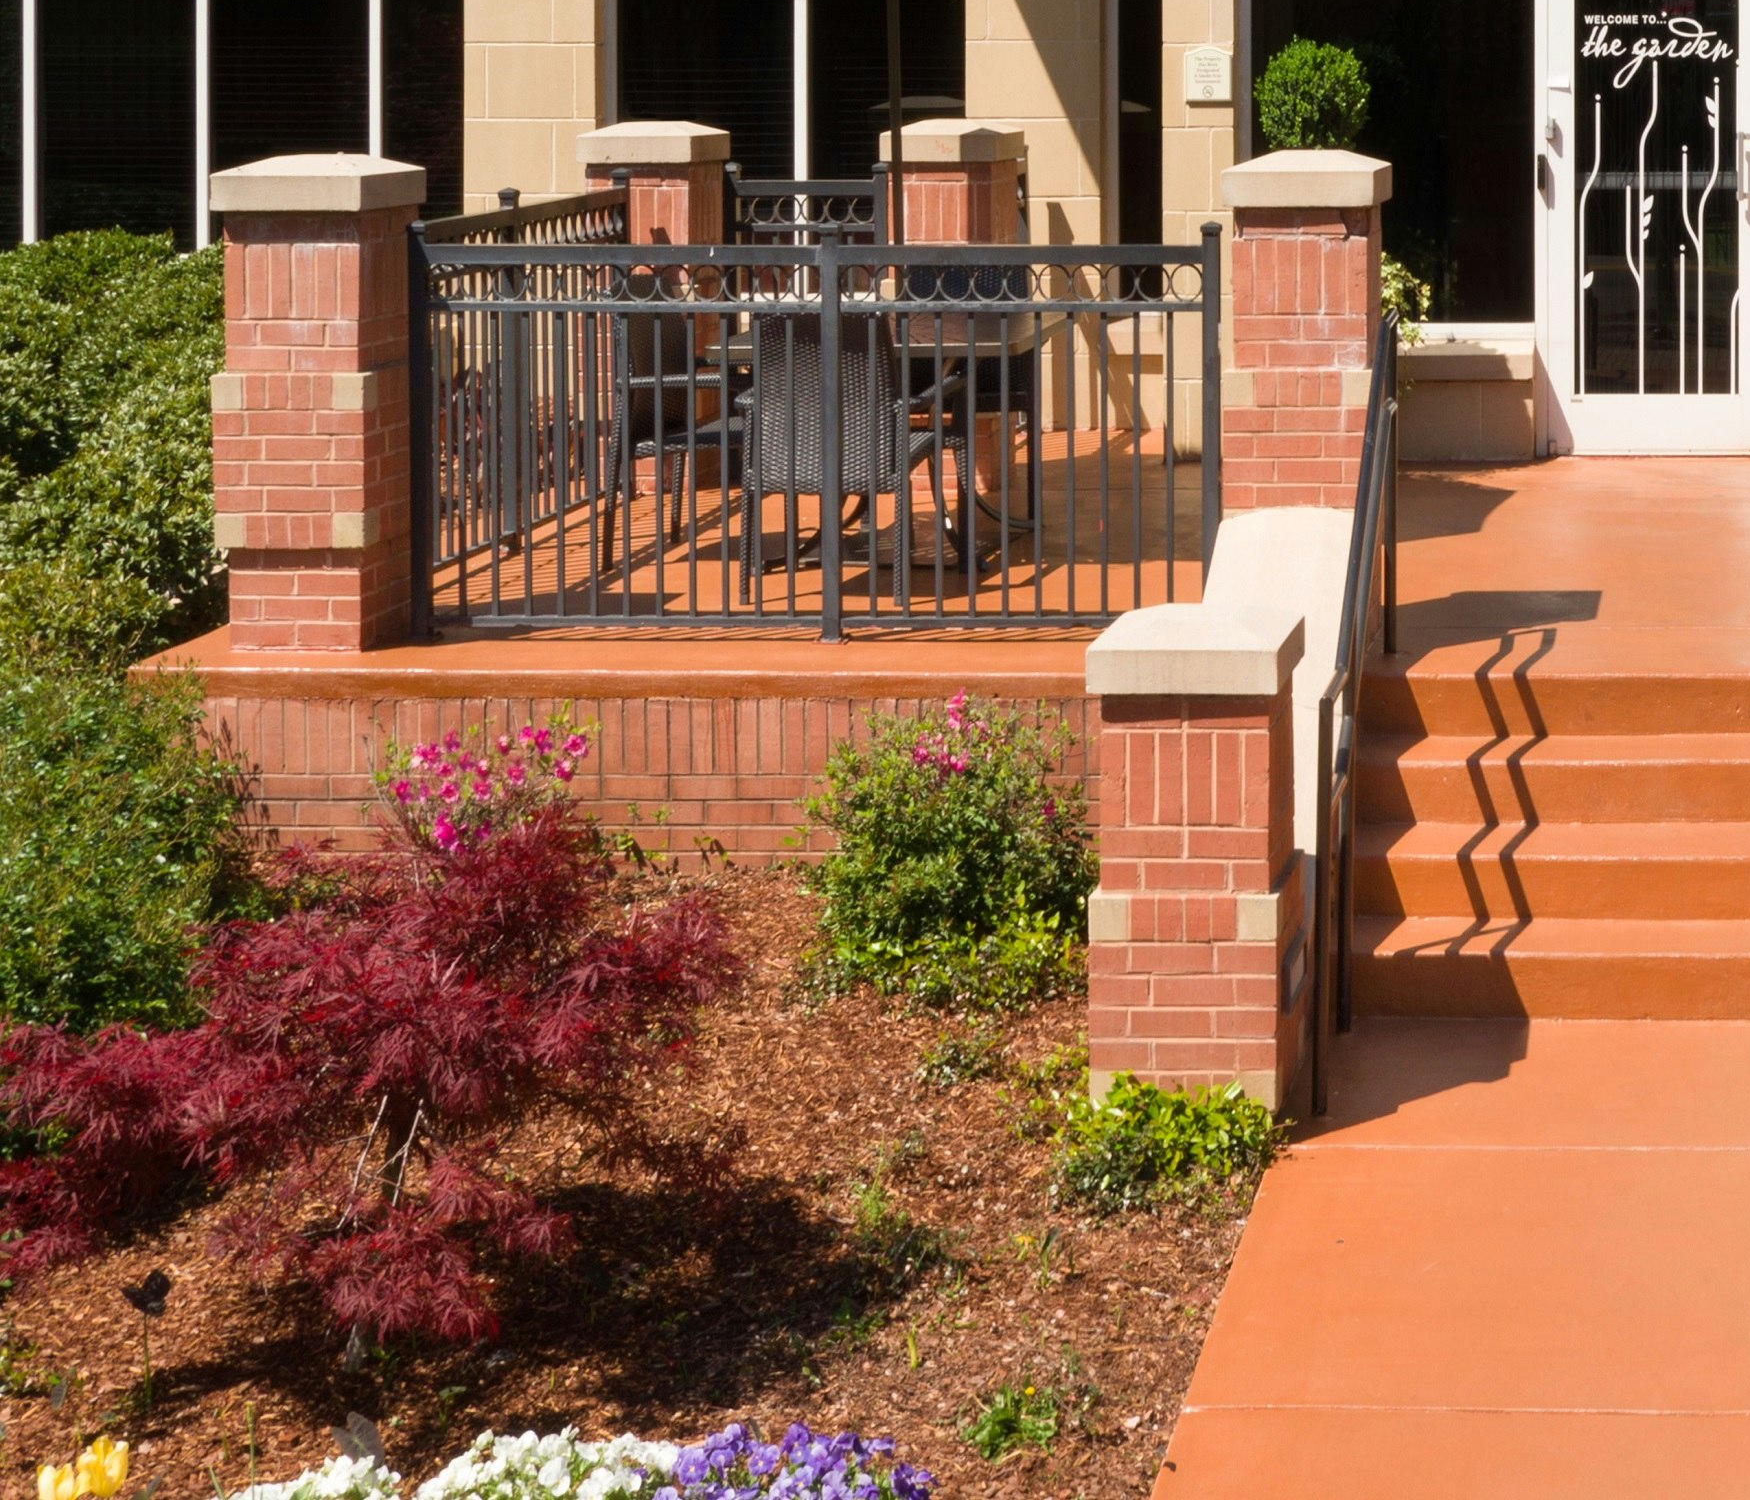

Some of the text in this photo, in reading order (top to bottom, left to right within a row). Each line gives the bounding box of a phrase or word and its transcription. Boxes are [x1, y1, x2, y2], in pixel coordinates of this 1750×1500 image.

[1584, 14, 1639, 25] WELCOME
[1580, 17, 1733, 89] the garden
